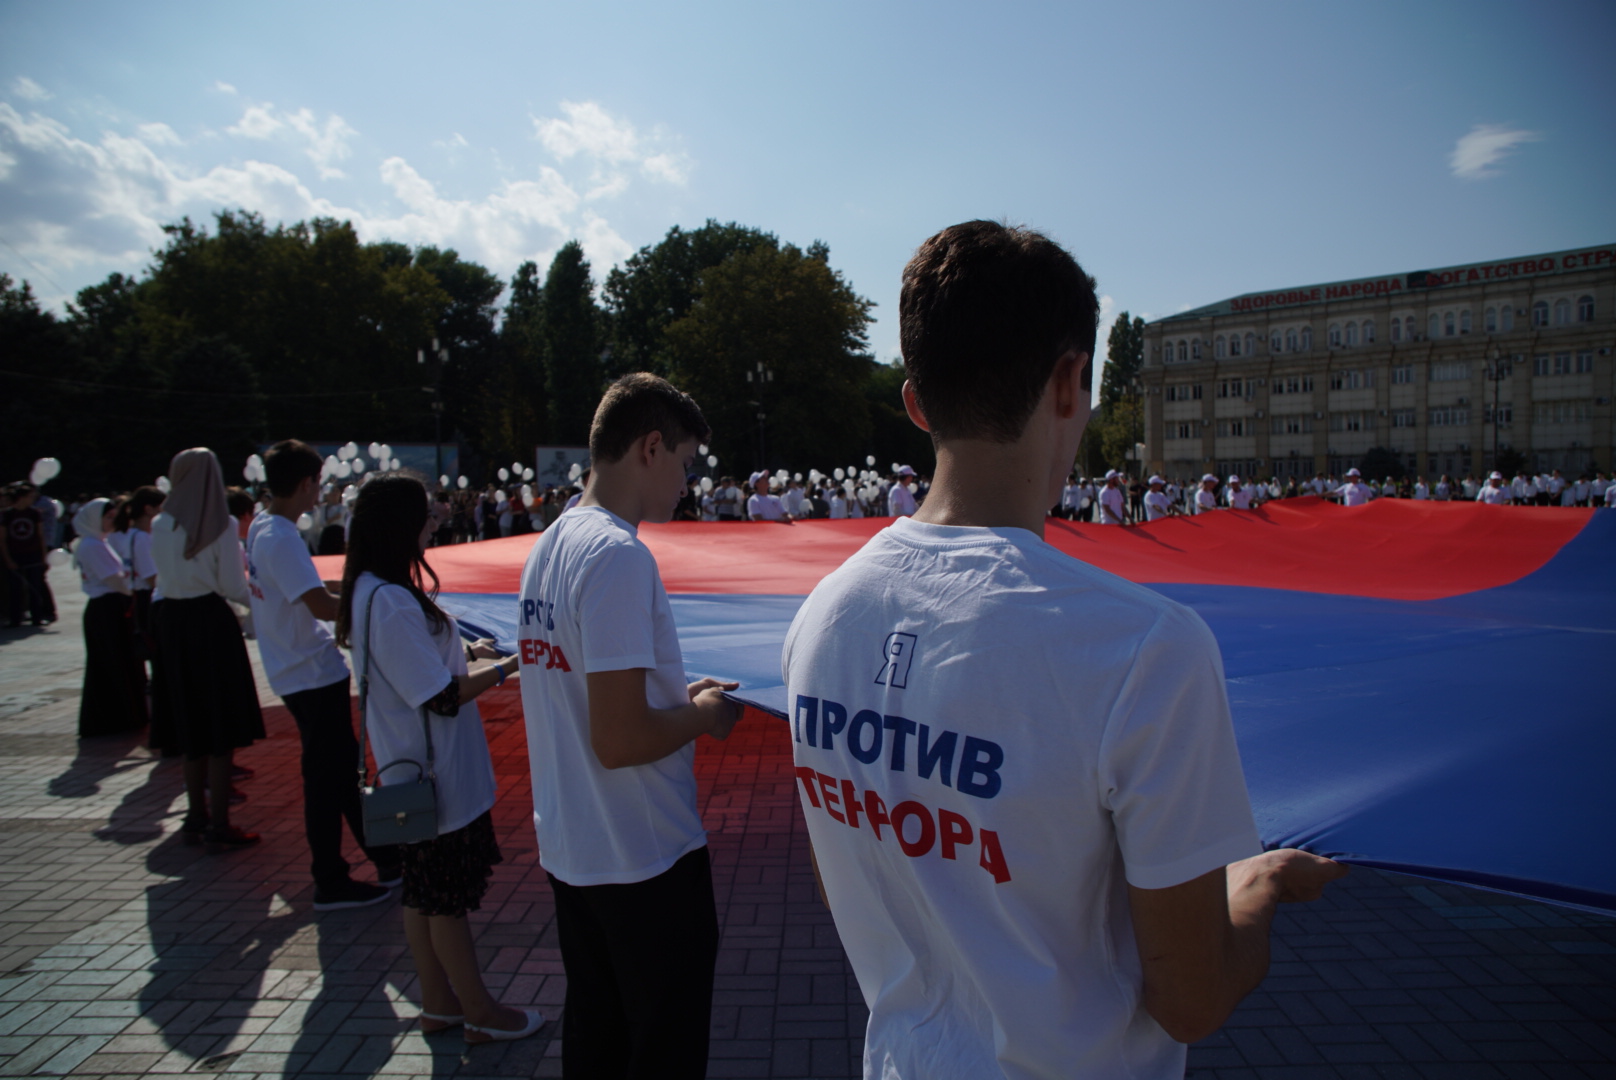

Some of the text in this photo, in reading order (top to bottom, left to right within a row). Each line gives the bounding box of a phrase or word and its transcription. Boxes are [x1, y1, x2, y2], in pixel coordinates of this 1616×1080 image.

[1230, 288, 1320, 312] ЗДОРОВЬЕ
[1325, 278, 1403, 300] НАРОДА
[874, 632, 918, 689] Я
[795, 694, 1004, 799] ПРОТИВ
